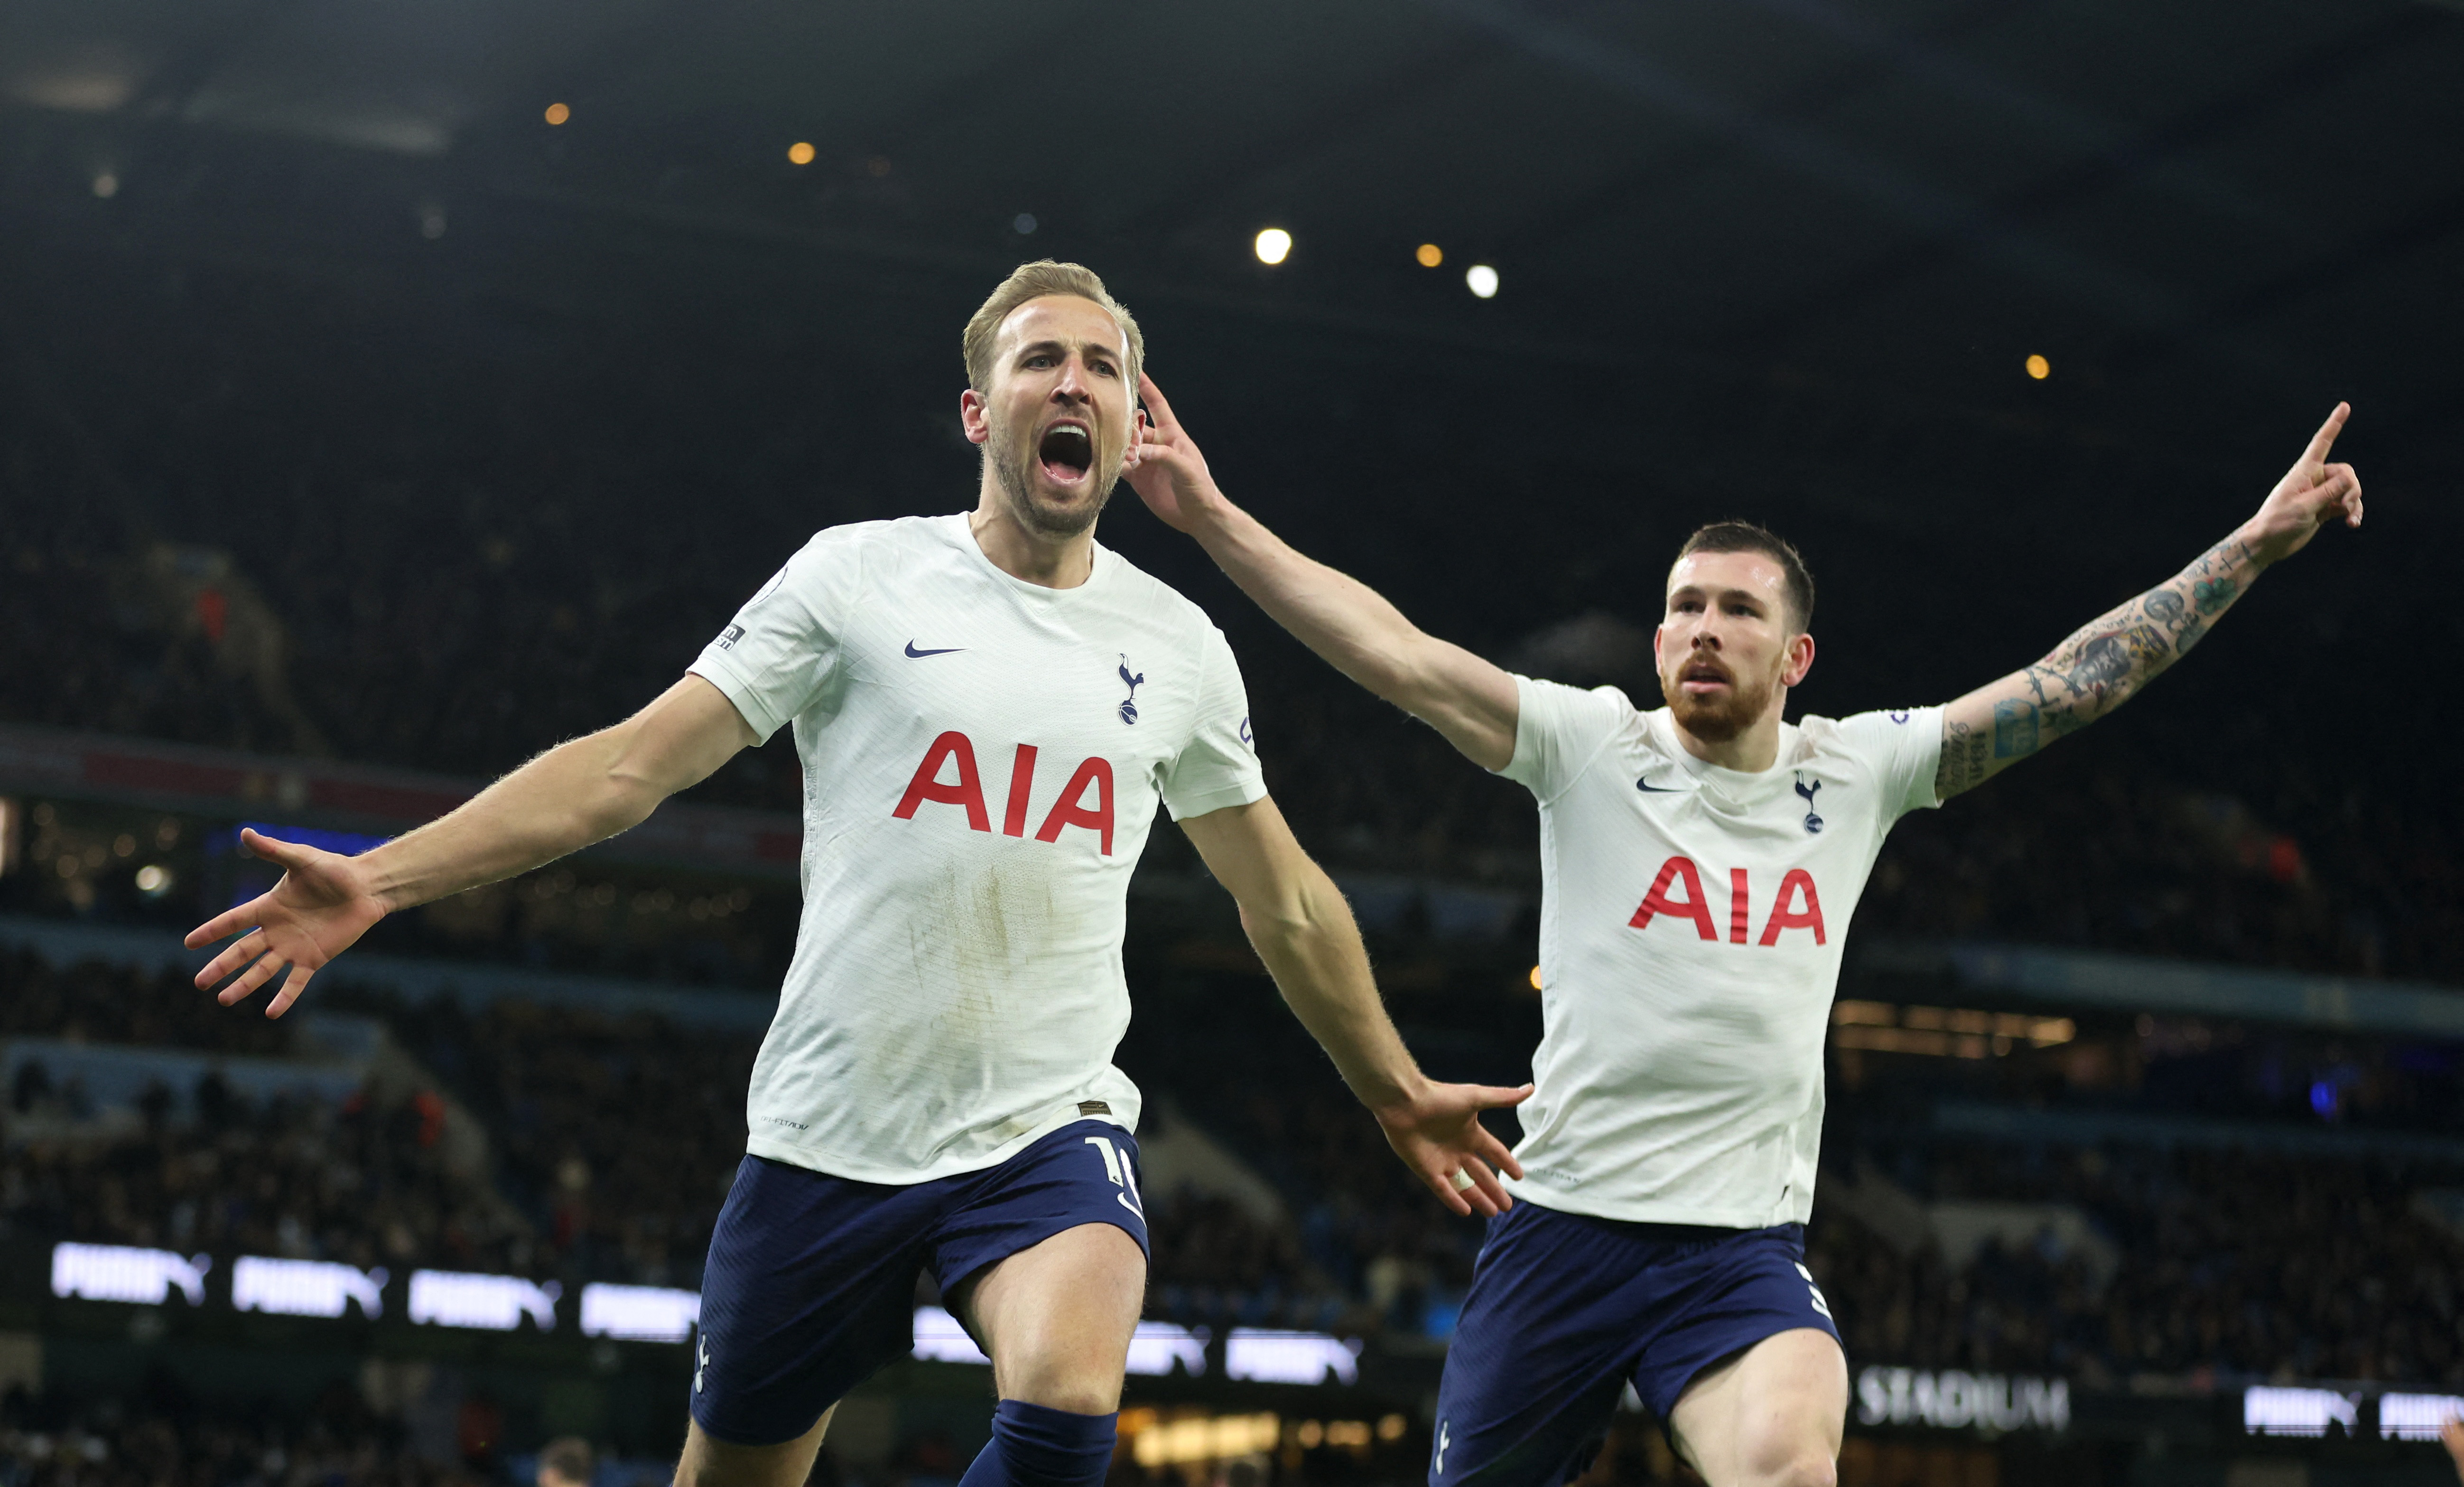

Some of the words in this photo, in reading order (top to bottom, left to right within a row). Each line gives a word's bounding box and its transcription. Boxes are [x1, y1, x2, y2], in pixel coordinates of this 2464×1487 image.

[892, 730, 1115, 857] AIA
[1628, 856, 1826, 947] AIA
[1857, 1365, 2070, 1431] STADIUM
